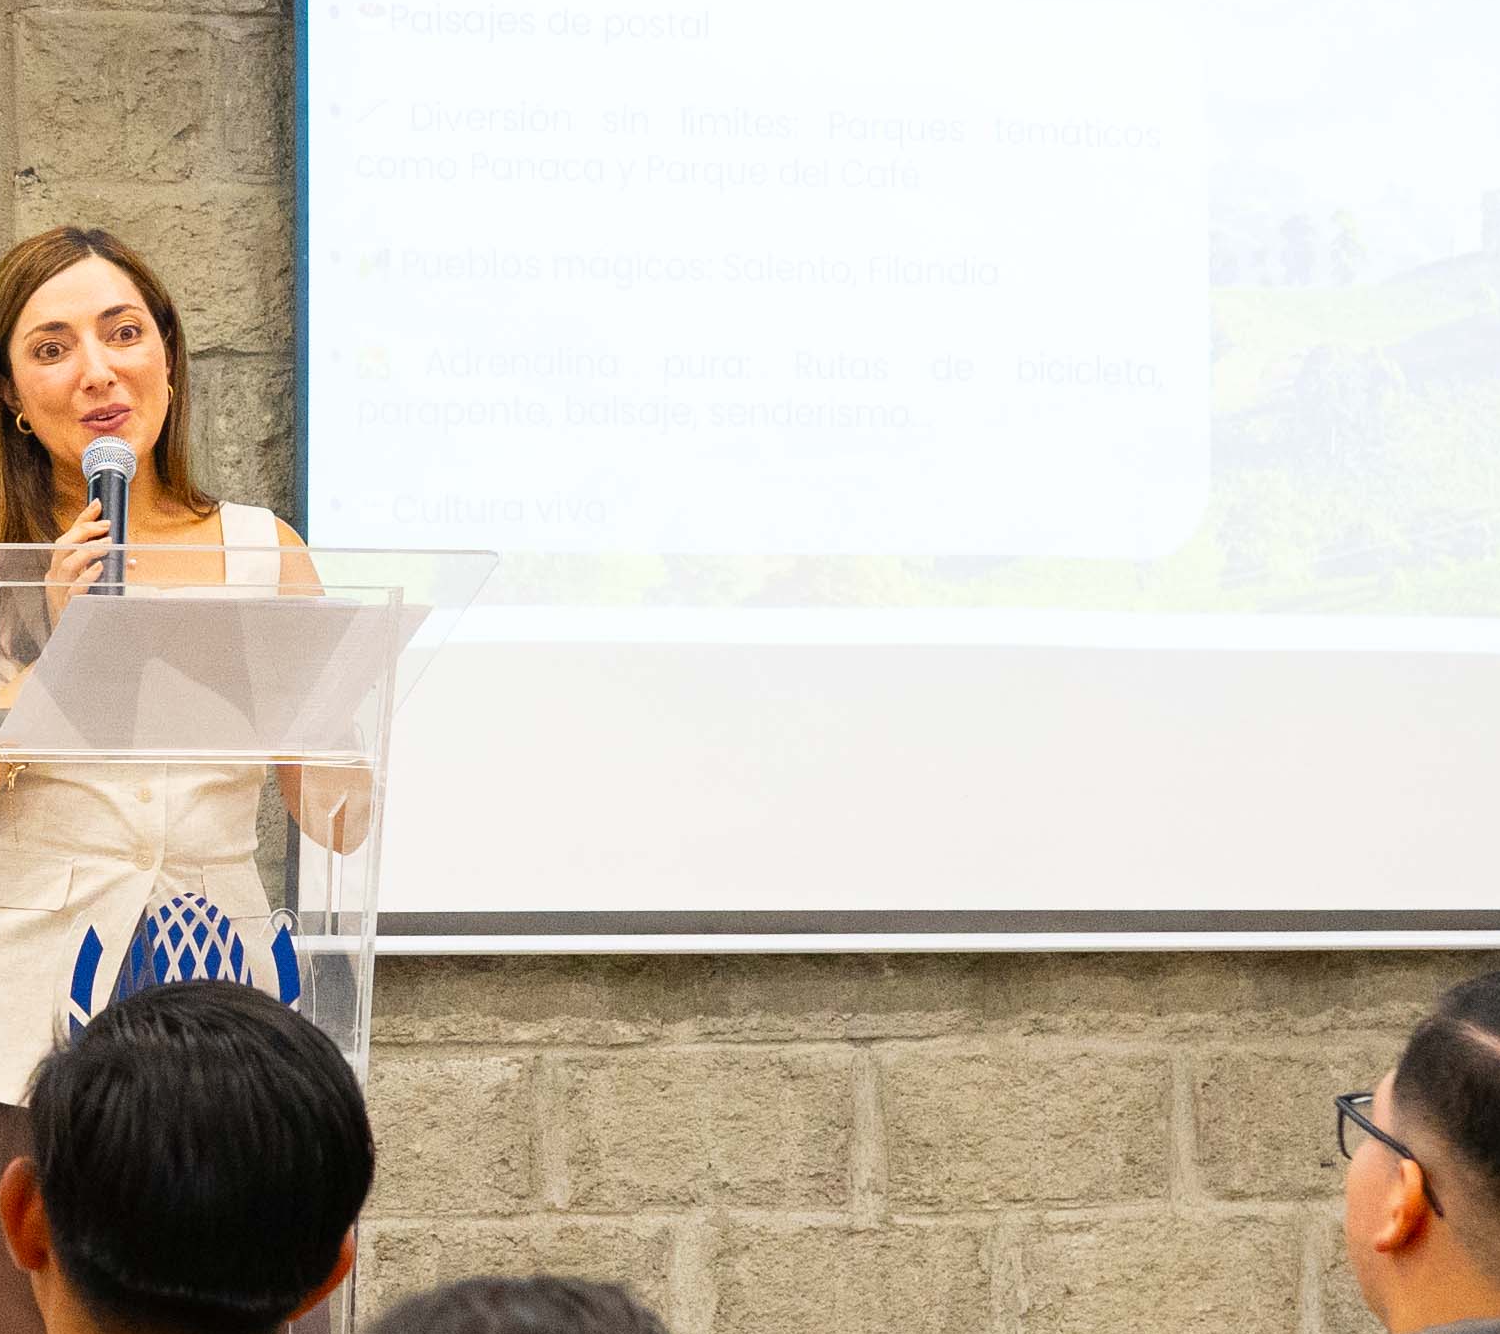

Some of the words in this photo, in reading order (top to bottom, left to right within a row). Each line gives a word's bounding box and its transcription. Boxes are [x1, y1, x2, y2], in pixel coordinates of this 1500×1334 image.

[390, 1, 536, 43] Paisajes
[547, 8, 592, 37] de
[604, 10, 711, 46] postal
[409, 100, 572, 133] Diversión
[602, 104, 650, 135] sin
[827, 108, 966, 149] Parques
[355, 155, 458, 181] como
[471, 151, 605, 184] Panaca
[617, 158, 636, 193] y
[647, 153, 768, 193] Parque
[779, 157, 829, 188] del
[841, 157, 920, 190] Café
[401, 245, 541, 281] Pueblos
[723, 253, 858, 288] Salento,
[868, 256, 999, 287] Filandia
[425, 347, 619, 379] Adrenalina
[793, 348, 889, 381] Rutas
[930, 353, 975, 382] de
[1016, 352, 1164, 390] bicicleta,
[357, 396, 552, 434] parapente,
[392, 494, 524, 524] Cultura
[535, 492, 606, 524] viva
